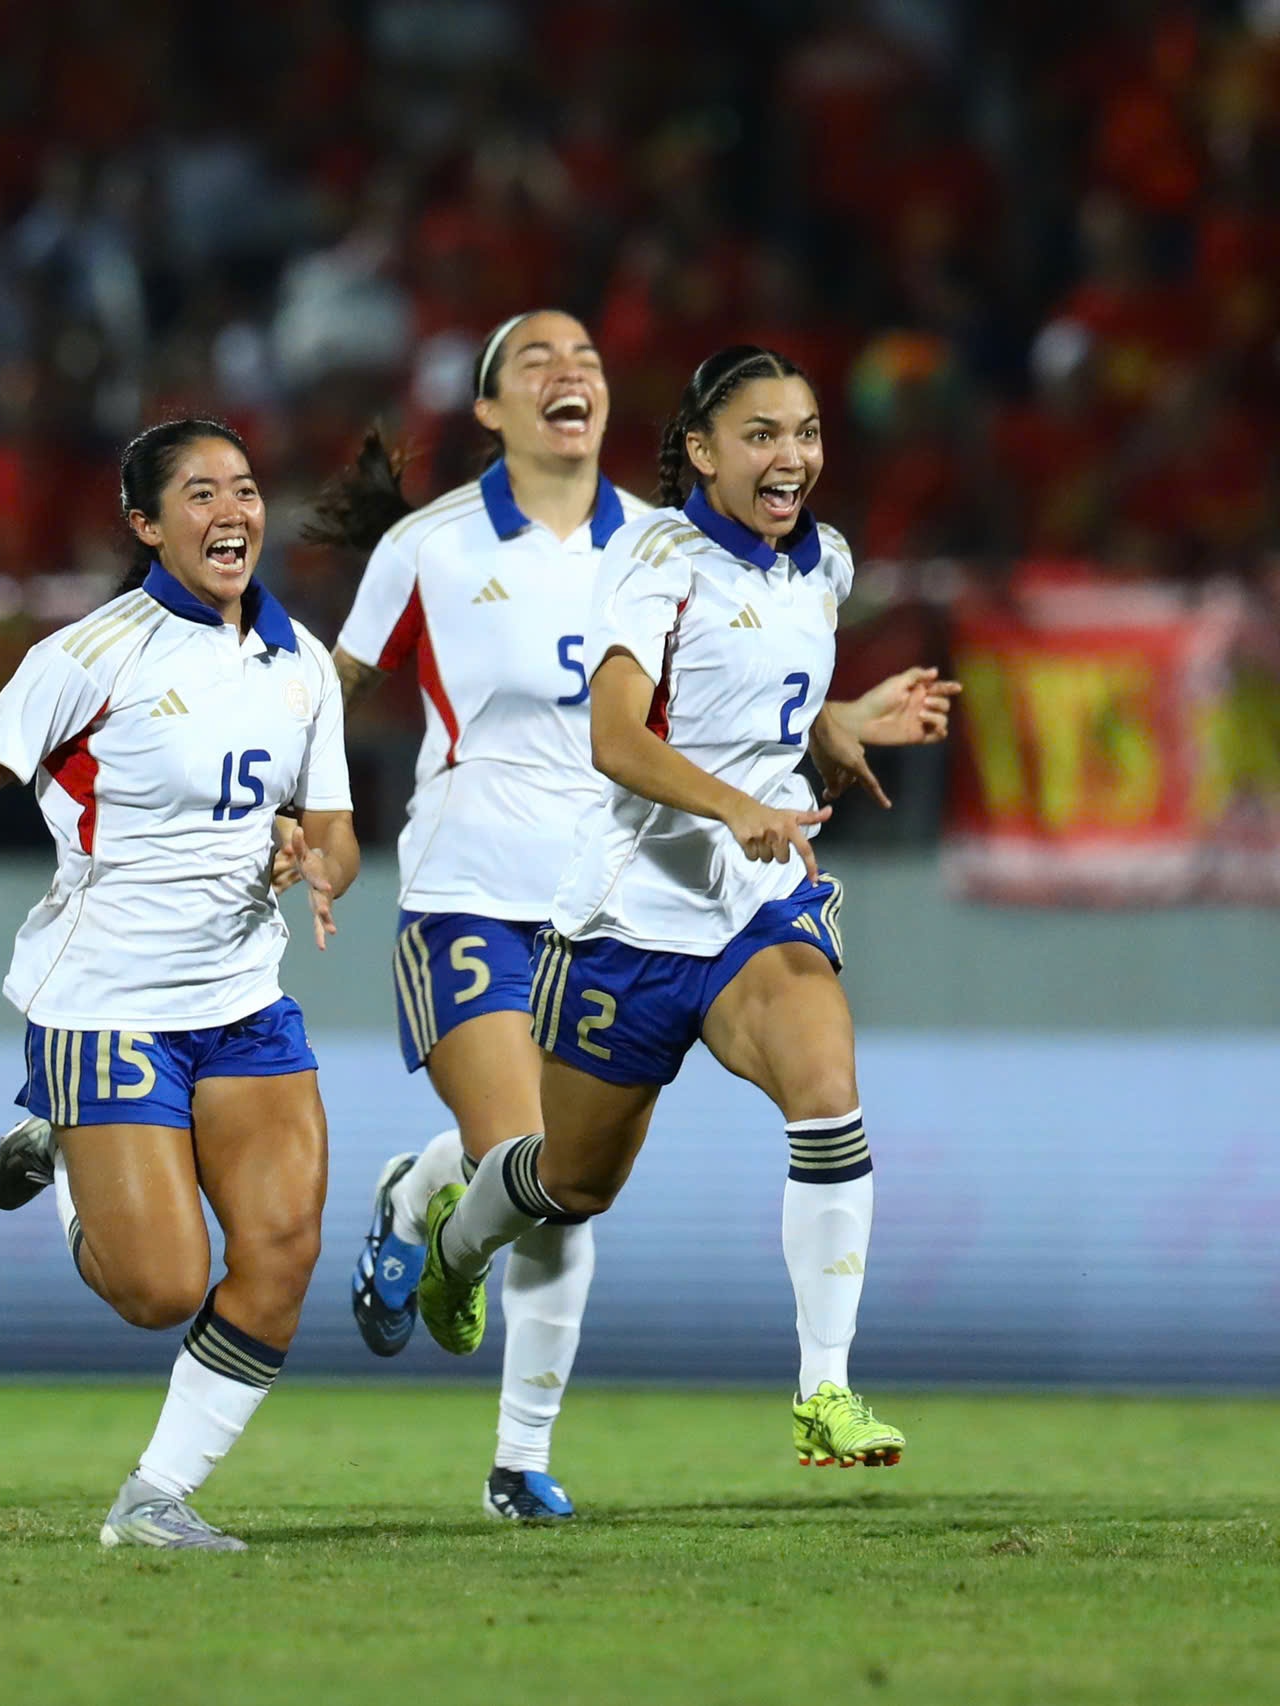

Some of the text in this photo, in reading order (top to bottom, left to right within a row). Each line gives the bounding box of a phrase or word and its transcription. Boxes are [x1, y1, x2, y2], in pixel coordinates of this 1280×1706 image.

[555, 635, 589, 707] 5
[780, 671, 810, 746] 2
[212, 749, 271, 821] 15
[450, 936, 491, 1004] 5
[577, 988, 617, 1061] 2
[96, 1031, 158, 1099] 15
